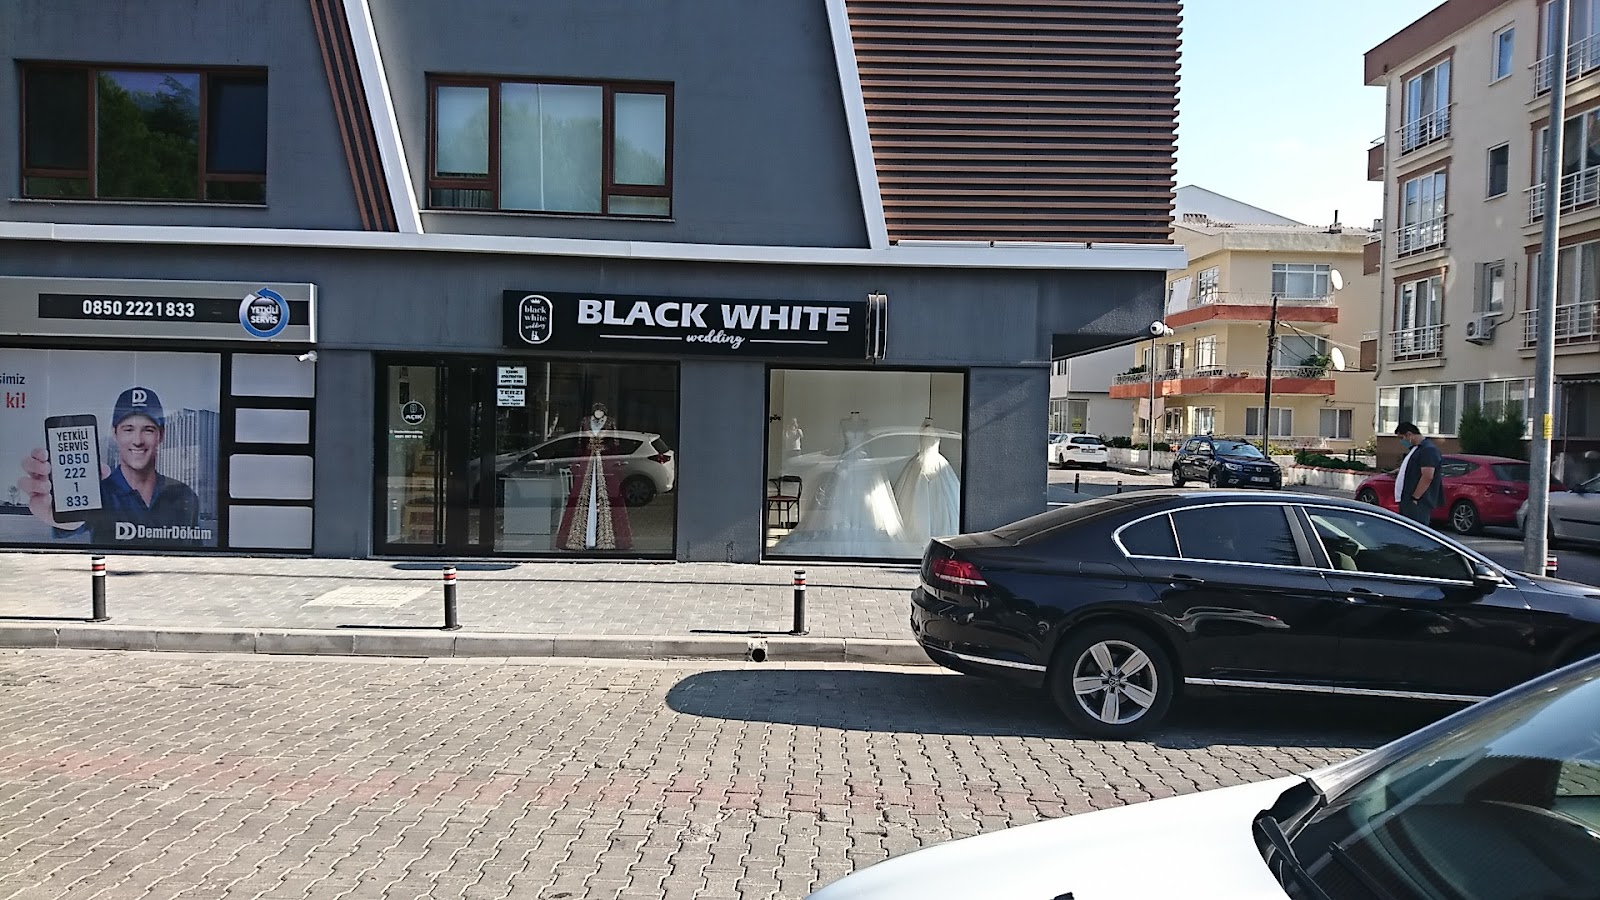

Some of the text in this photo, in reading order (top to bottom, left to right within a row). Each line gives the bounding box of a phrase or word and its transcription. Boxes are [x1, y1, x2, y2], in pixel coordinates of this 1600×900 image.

[82, 299, 123, 315] 0850
[250, 304, 279, 315] YETKİLİ
[524, 305, 547, 314] black
[250, 314, 278, 324] SERVİS
[577, 299, 851, 332] BLACK WHITE
[686, 329, 746, 350] wedding
[6, 392, 26, 409] ki!
[56, 428, 88, 441] YETKİLİ
[57, 440, 89, 452] SERVİS
[59, 453, 90, 465] 0850
[64, 467, 86, 479] 222
[74, 482, 79, 492] 1
[66, 495, 89, 507] 833
[137, 524, 212, 540] DemirDöküm
